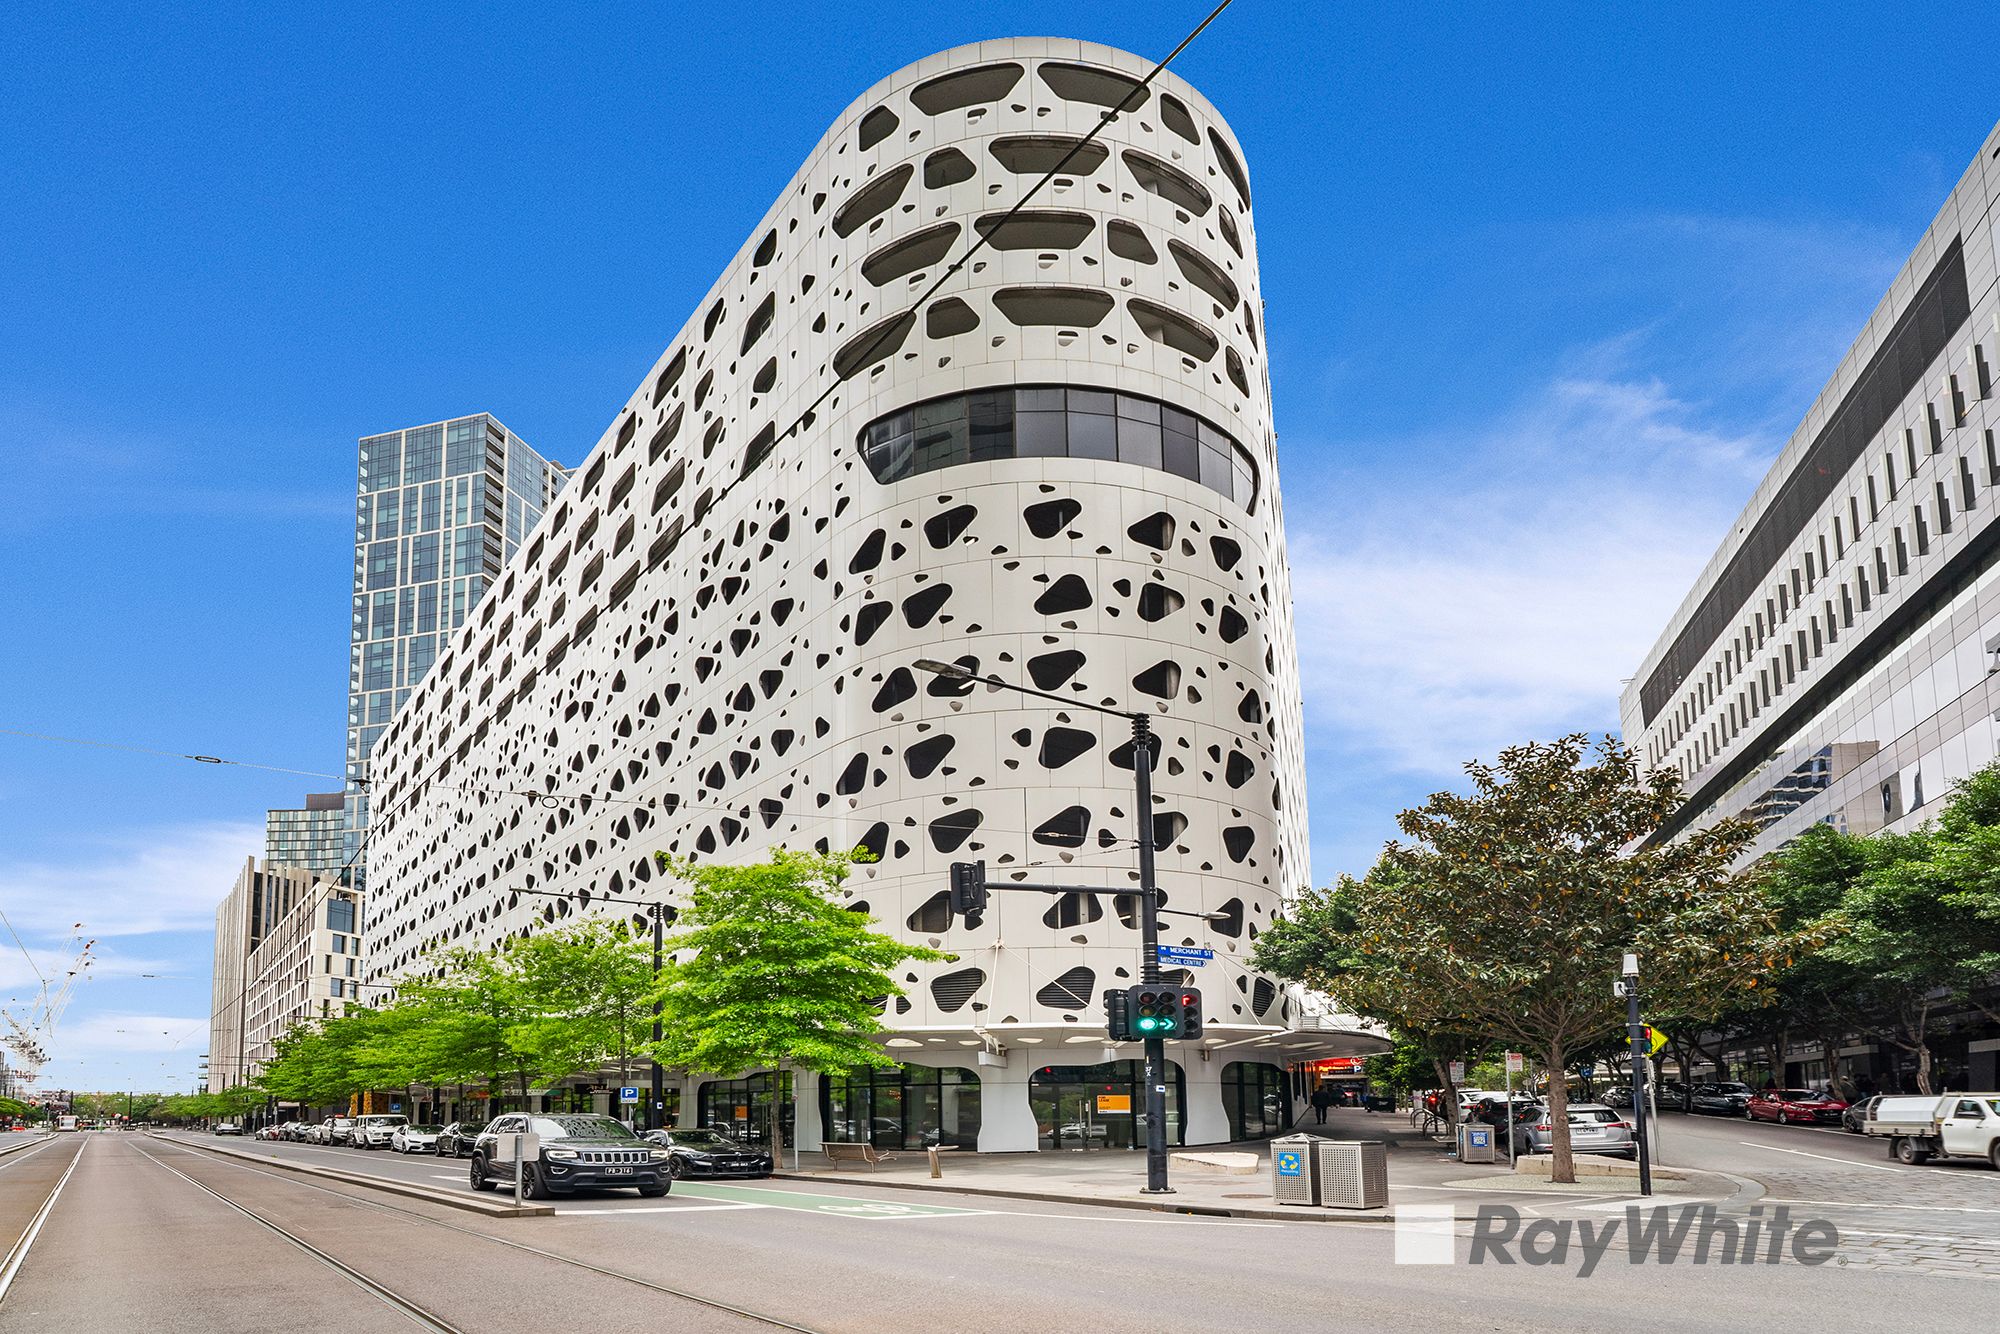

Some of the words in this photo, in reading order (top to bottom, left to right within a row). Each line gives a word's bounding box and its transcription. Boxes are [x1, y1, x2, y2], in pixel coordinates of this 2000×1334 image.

[1170, 947, 1202, 955] MERCHANT
[1161, 956, 1181, 964] MEDICAL
[625, 1089, 634, 1097] P
